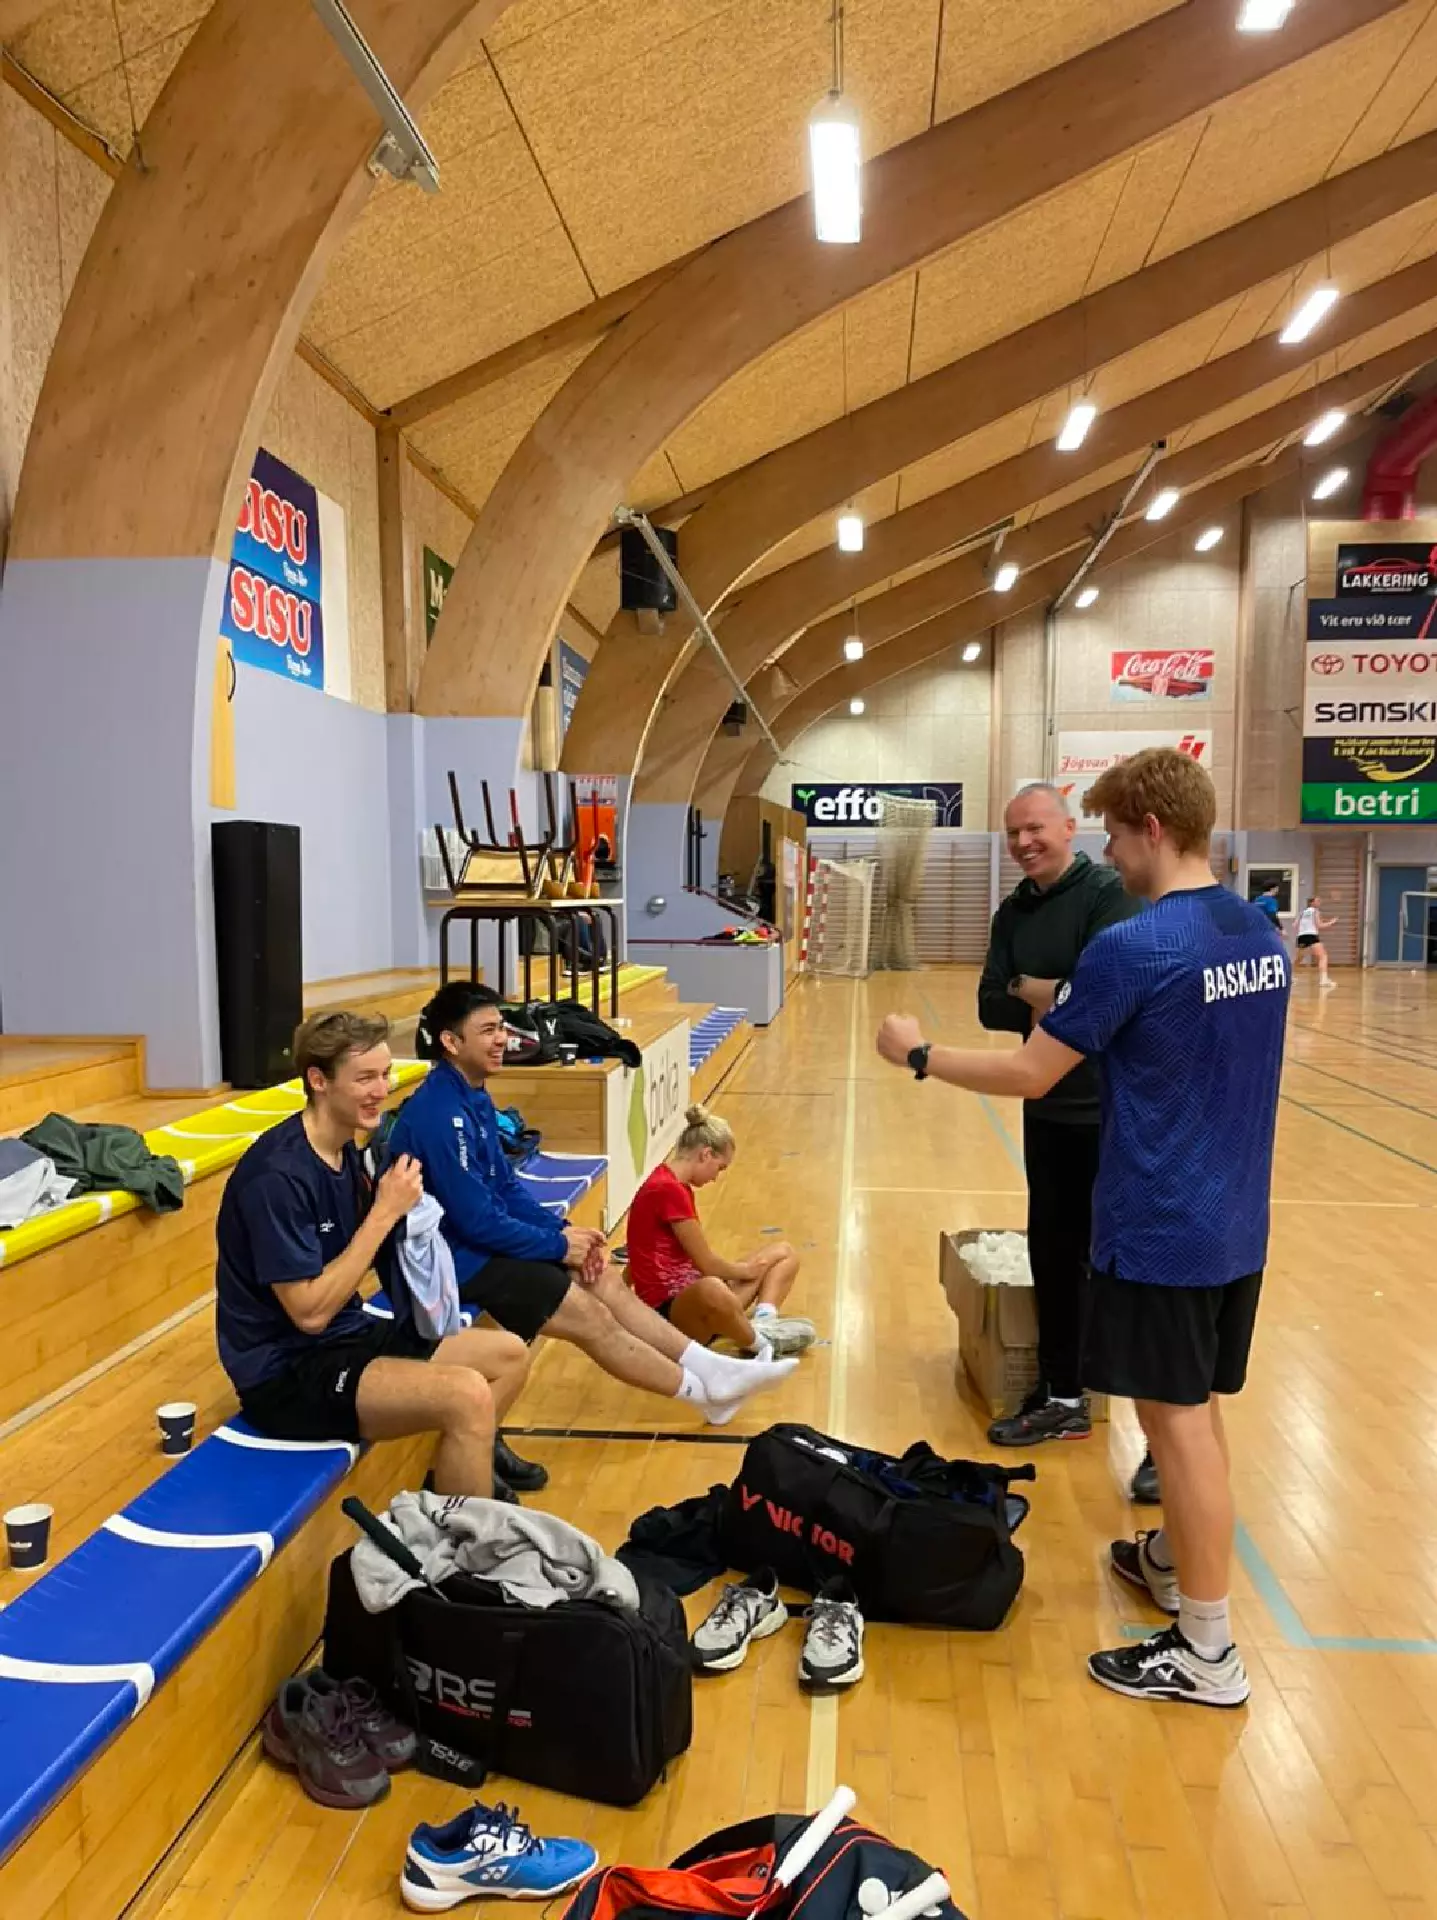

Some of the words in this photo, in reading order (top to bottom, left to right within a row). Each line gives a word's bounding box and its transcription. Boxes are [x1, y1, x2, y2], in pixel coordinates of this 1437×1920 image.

[1341, 572, 1429, 588] LAKKERING
[230, 566, 312, 656] SISU
[814, 787, 884, 821] effo
[1334, 787, 1420, 816] betri
[1203, 954, 1287, 1004] BASKJÆR
